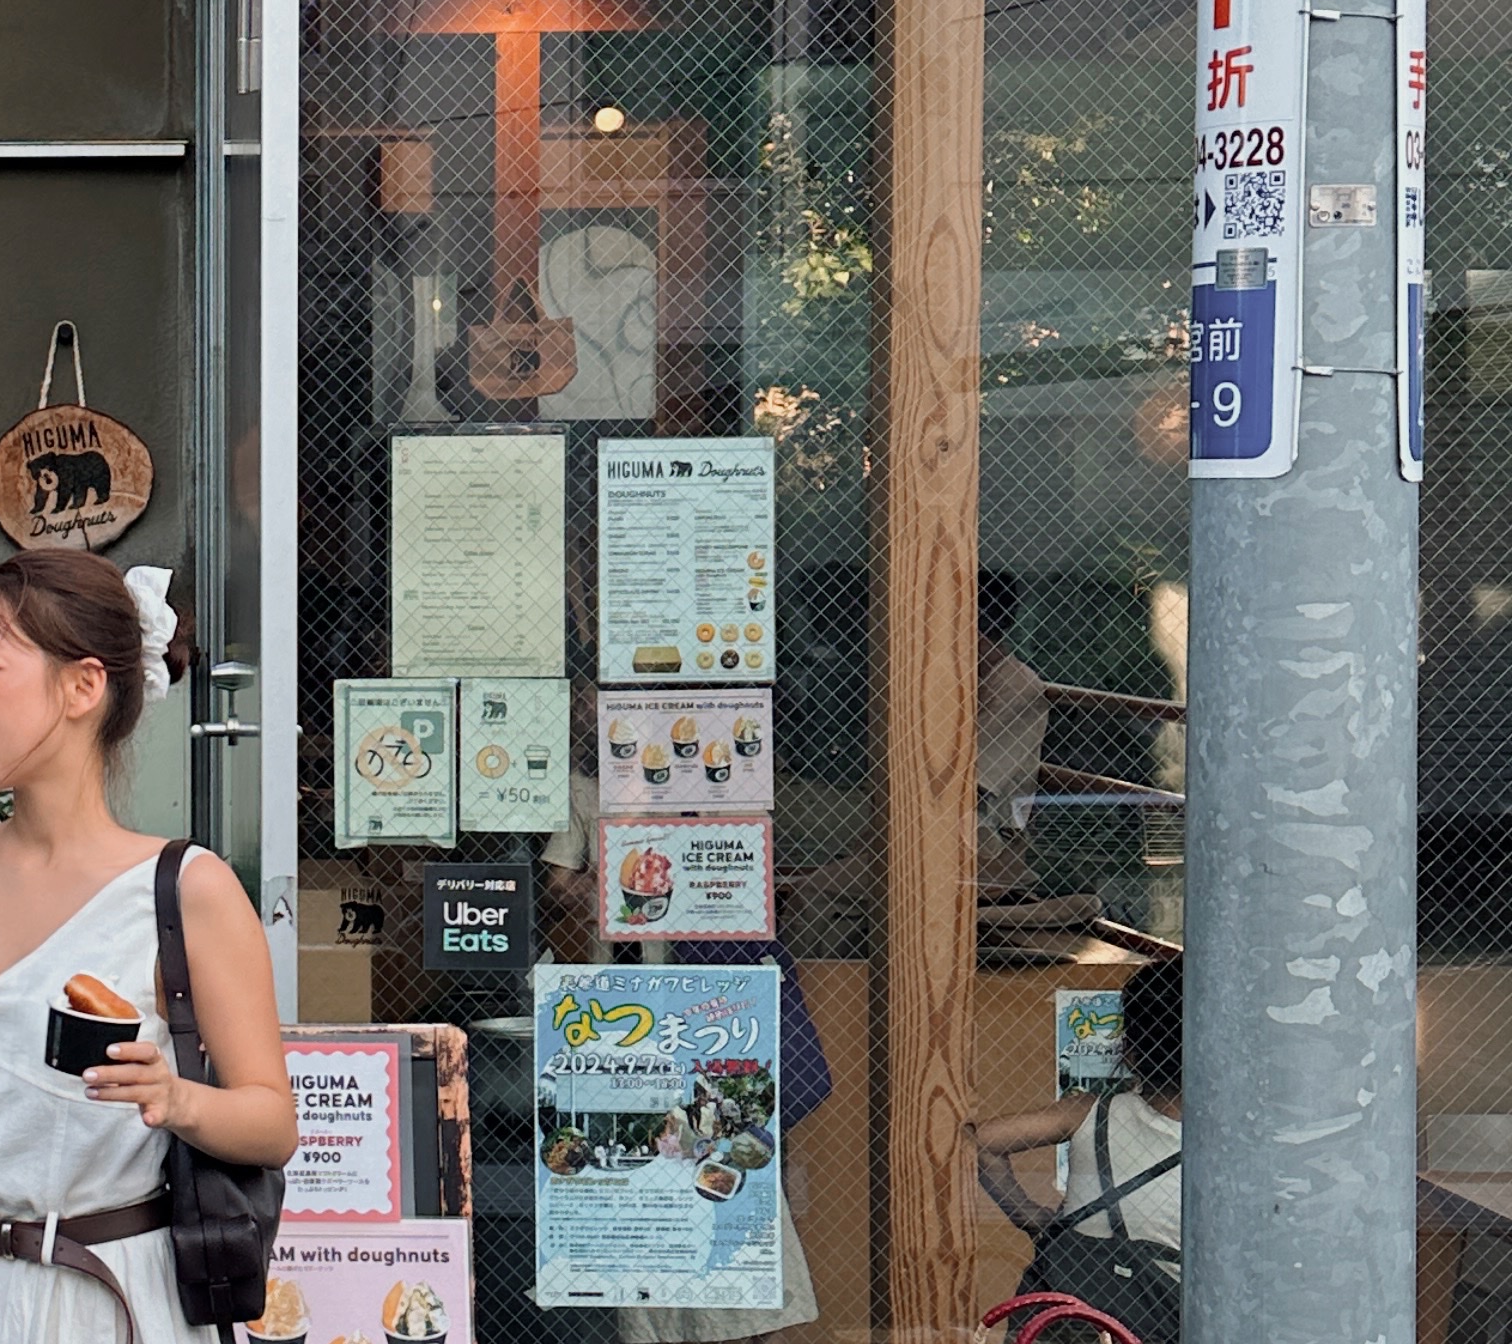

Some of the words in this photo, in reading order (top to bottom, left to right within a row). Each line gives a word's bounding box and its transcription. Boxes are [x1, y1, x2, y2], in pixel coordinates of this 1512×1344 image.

[1195, 126, 1284, 174] 4-3228
[21, 421, 104, 459] HIGUMA
[607, 460, 664, 480] HIGUMA
[698, 460, 767, 482] Doughnuts
[29, 510, 119, 539] Doughnuts
[691, 840, 744, 851] HIGUMA
[681, 852, 704, 863] ICE
[706, 852, 754, 863] CREAM
[442, 901, 509, 926] Uber
[442, 928, 510, 953] Eats
[552, 994, 656, 1048] なつ
[656, 1011, 761, 1056] まつり
[305, 1093, 373, 1108] CREAM
[302, 1110, 373, 1123] doughnuts
[302, 1151, 341, 1163] ¥900
[301, 1247, 342, 1263] with
[347, 1247, 451, 1266] doughnuts
